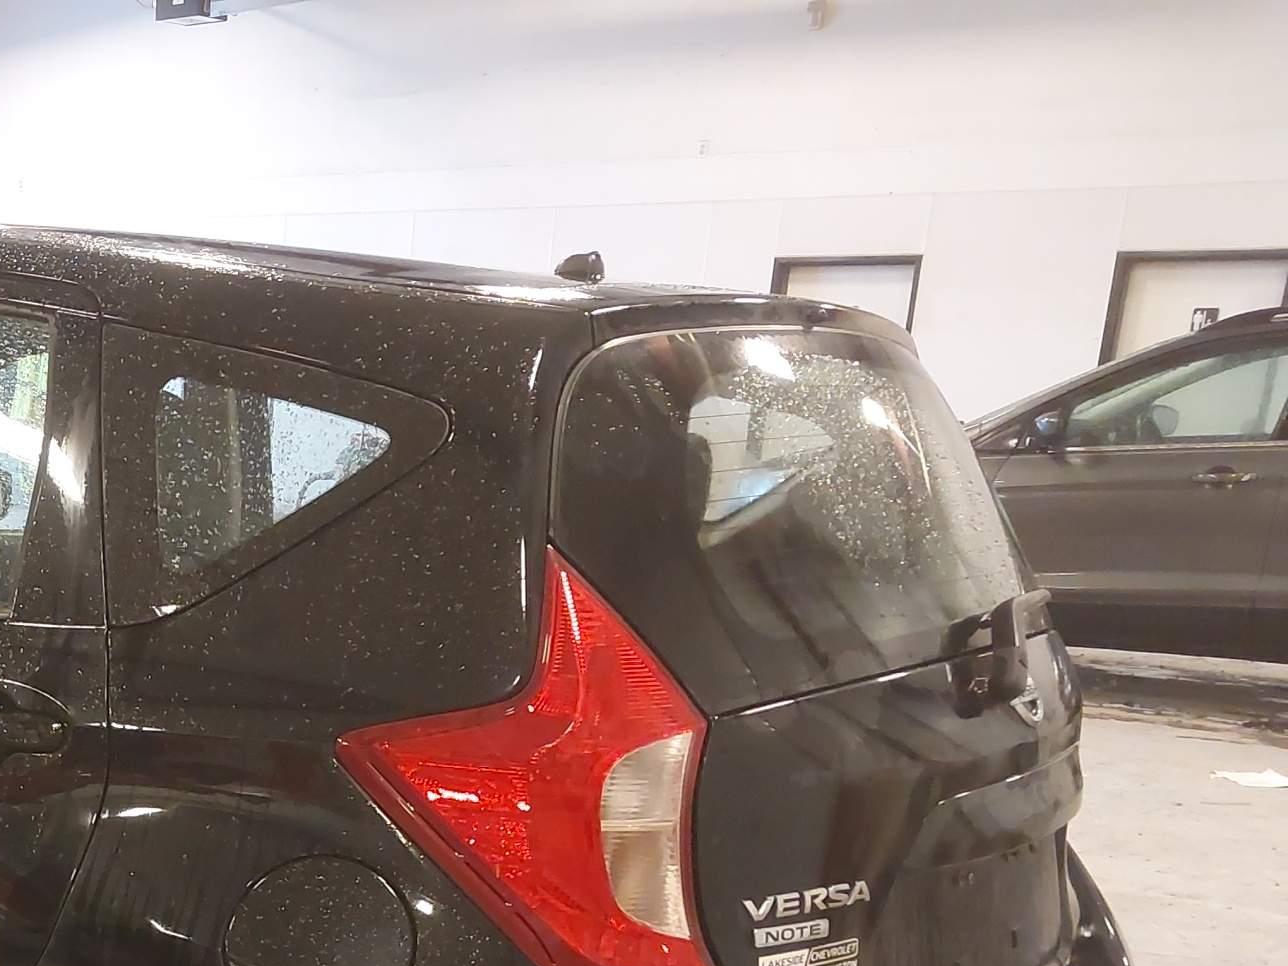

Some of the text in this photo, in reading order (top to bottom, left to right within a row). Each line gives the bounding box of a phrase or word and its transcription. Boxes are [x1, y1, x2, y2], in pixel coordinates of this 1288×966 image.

[742, 880, 870, 921] VERSA
[765, 923, 821, 944] NOTE
[810, 944, 856, 961] CHEVROLET
